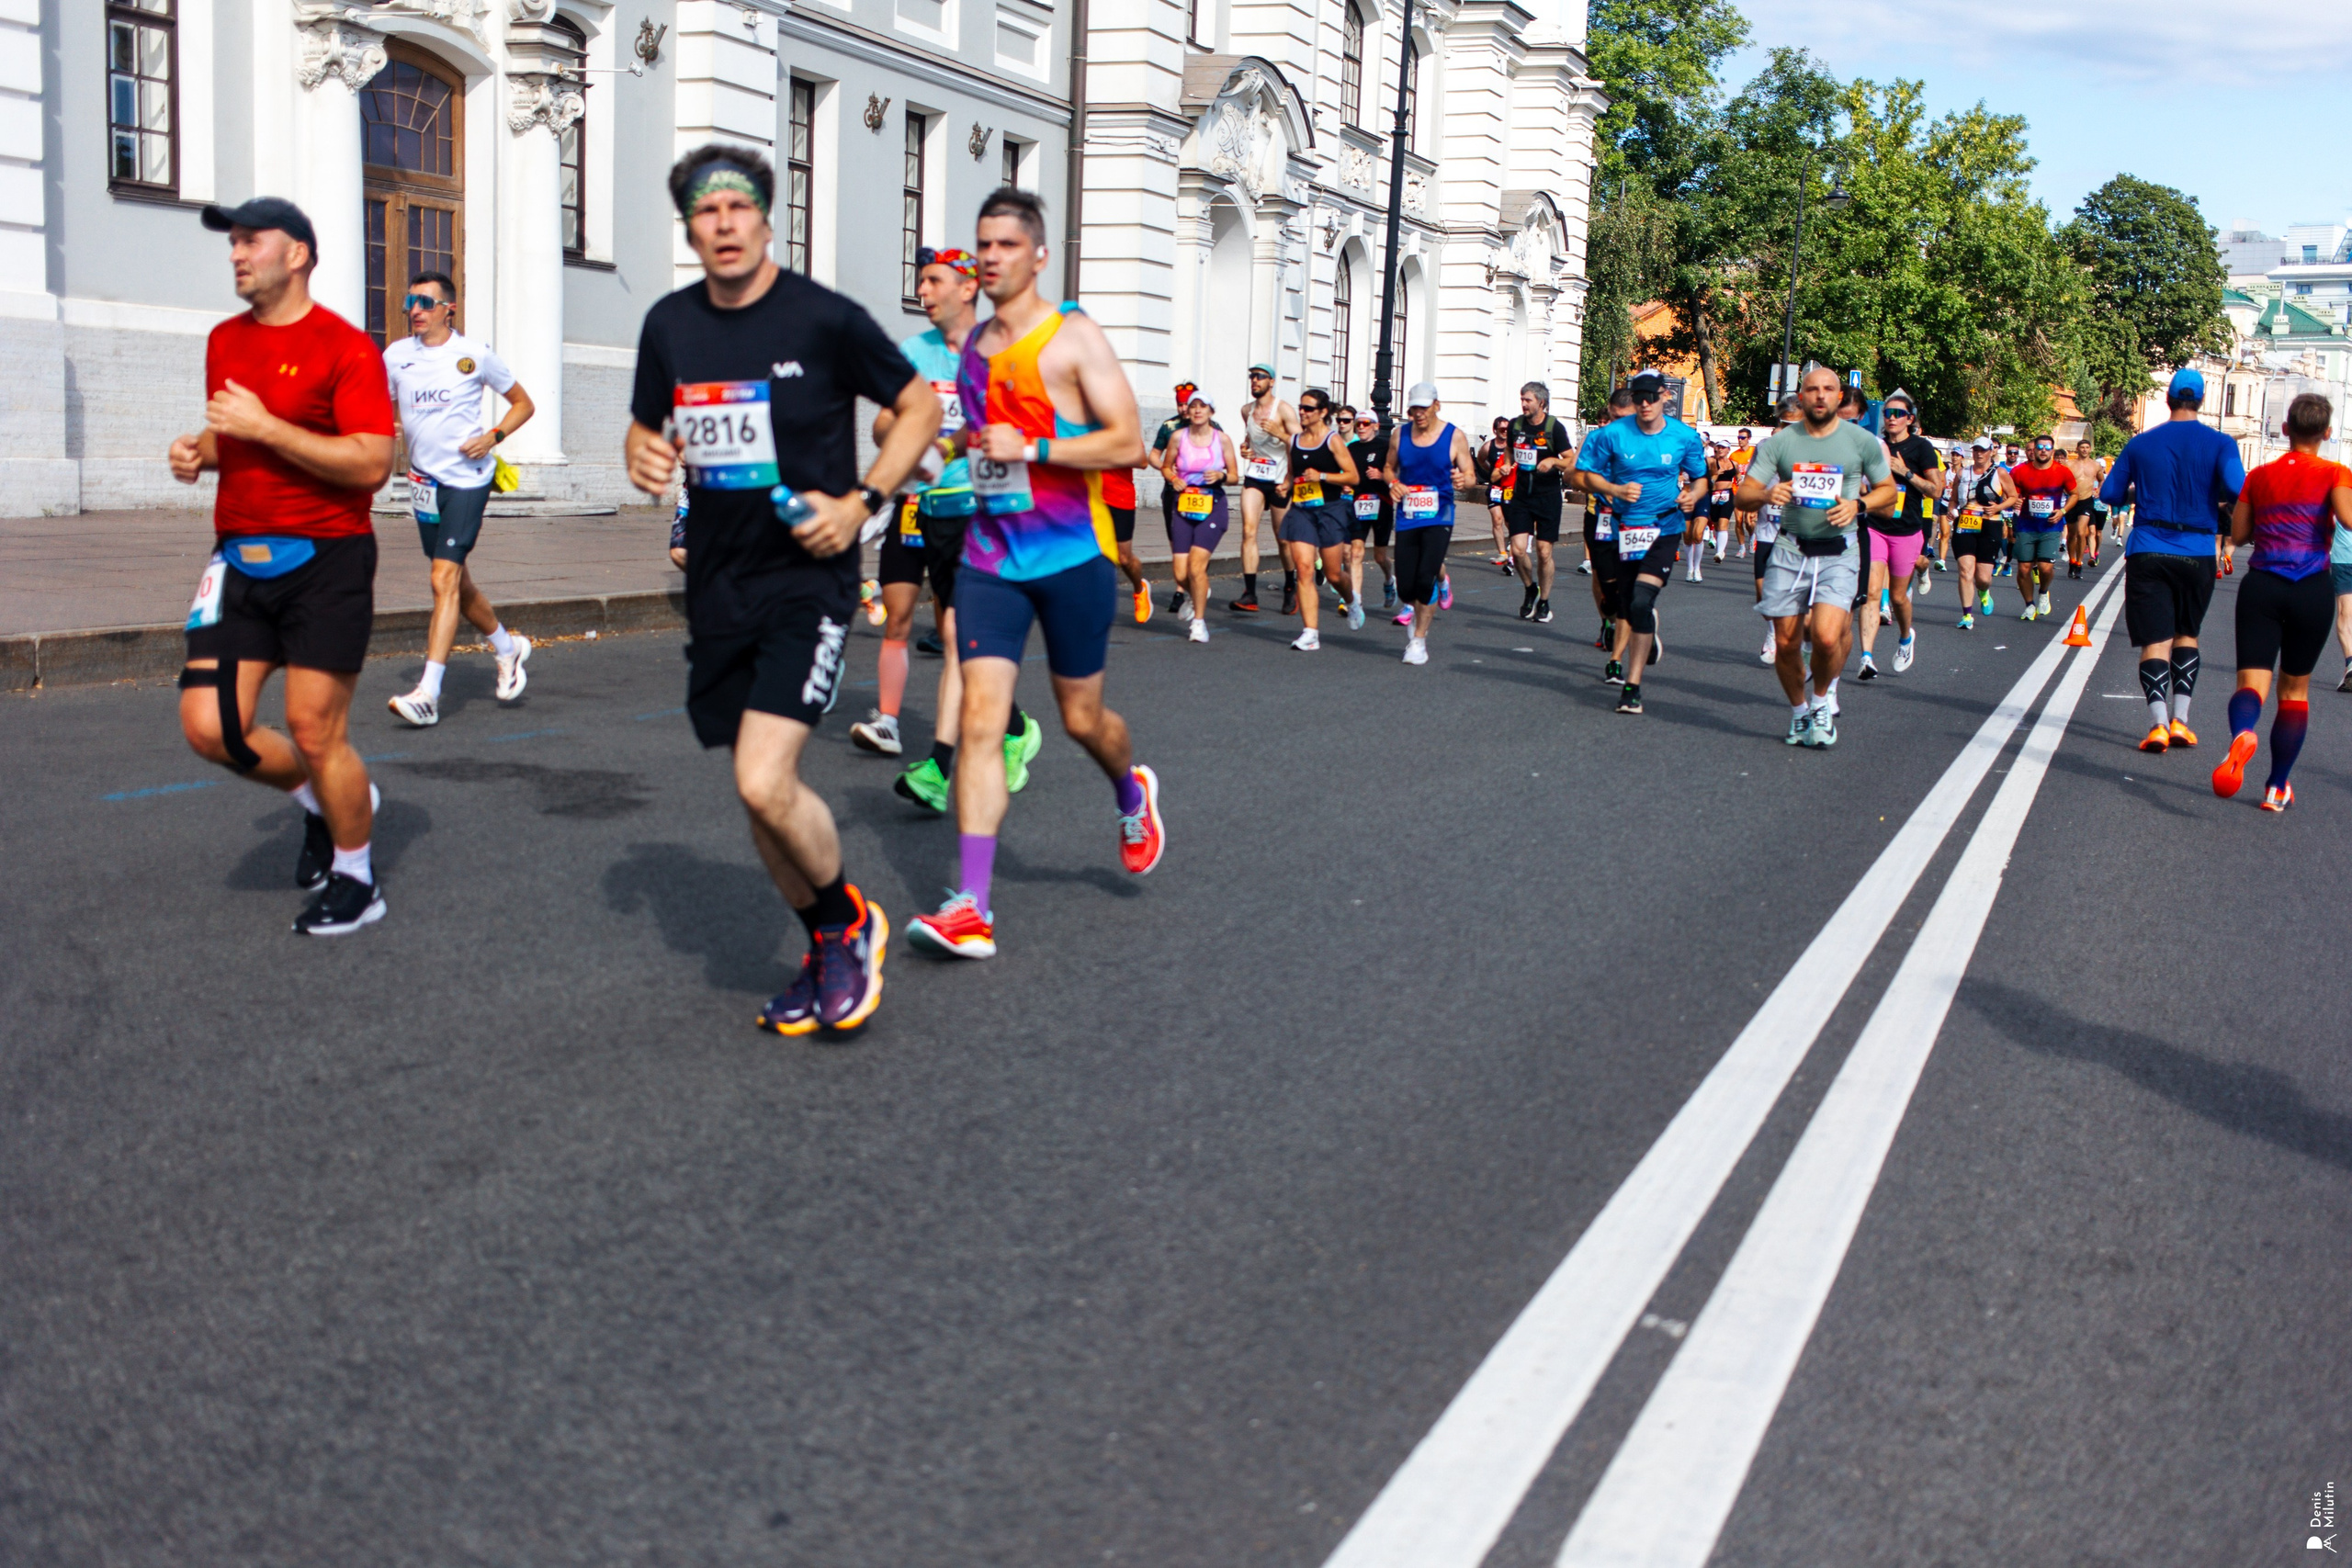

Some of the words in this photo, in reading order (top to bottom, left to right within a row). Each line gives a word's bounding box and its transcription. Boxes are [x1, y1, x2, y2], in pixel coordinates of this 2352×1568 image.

[414, 389, 450, 403] ИКС
[685, 413, 756, 446] 2816
[1799, 476, 1836, 491] 3439
[1187, 497, 1204, 507] 183
[1407, 497, 1433, 507] 7088
[2031, 502, 2050, 510] 5056
[1960, 517, 1978, 525] 6016
[1624, 533, 1654, 545] 5645
